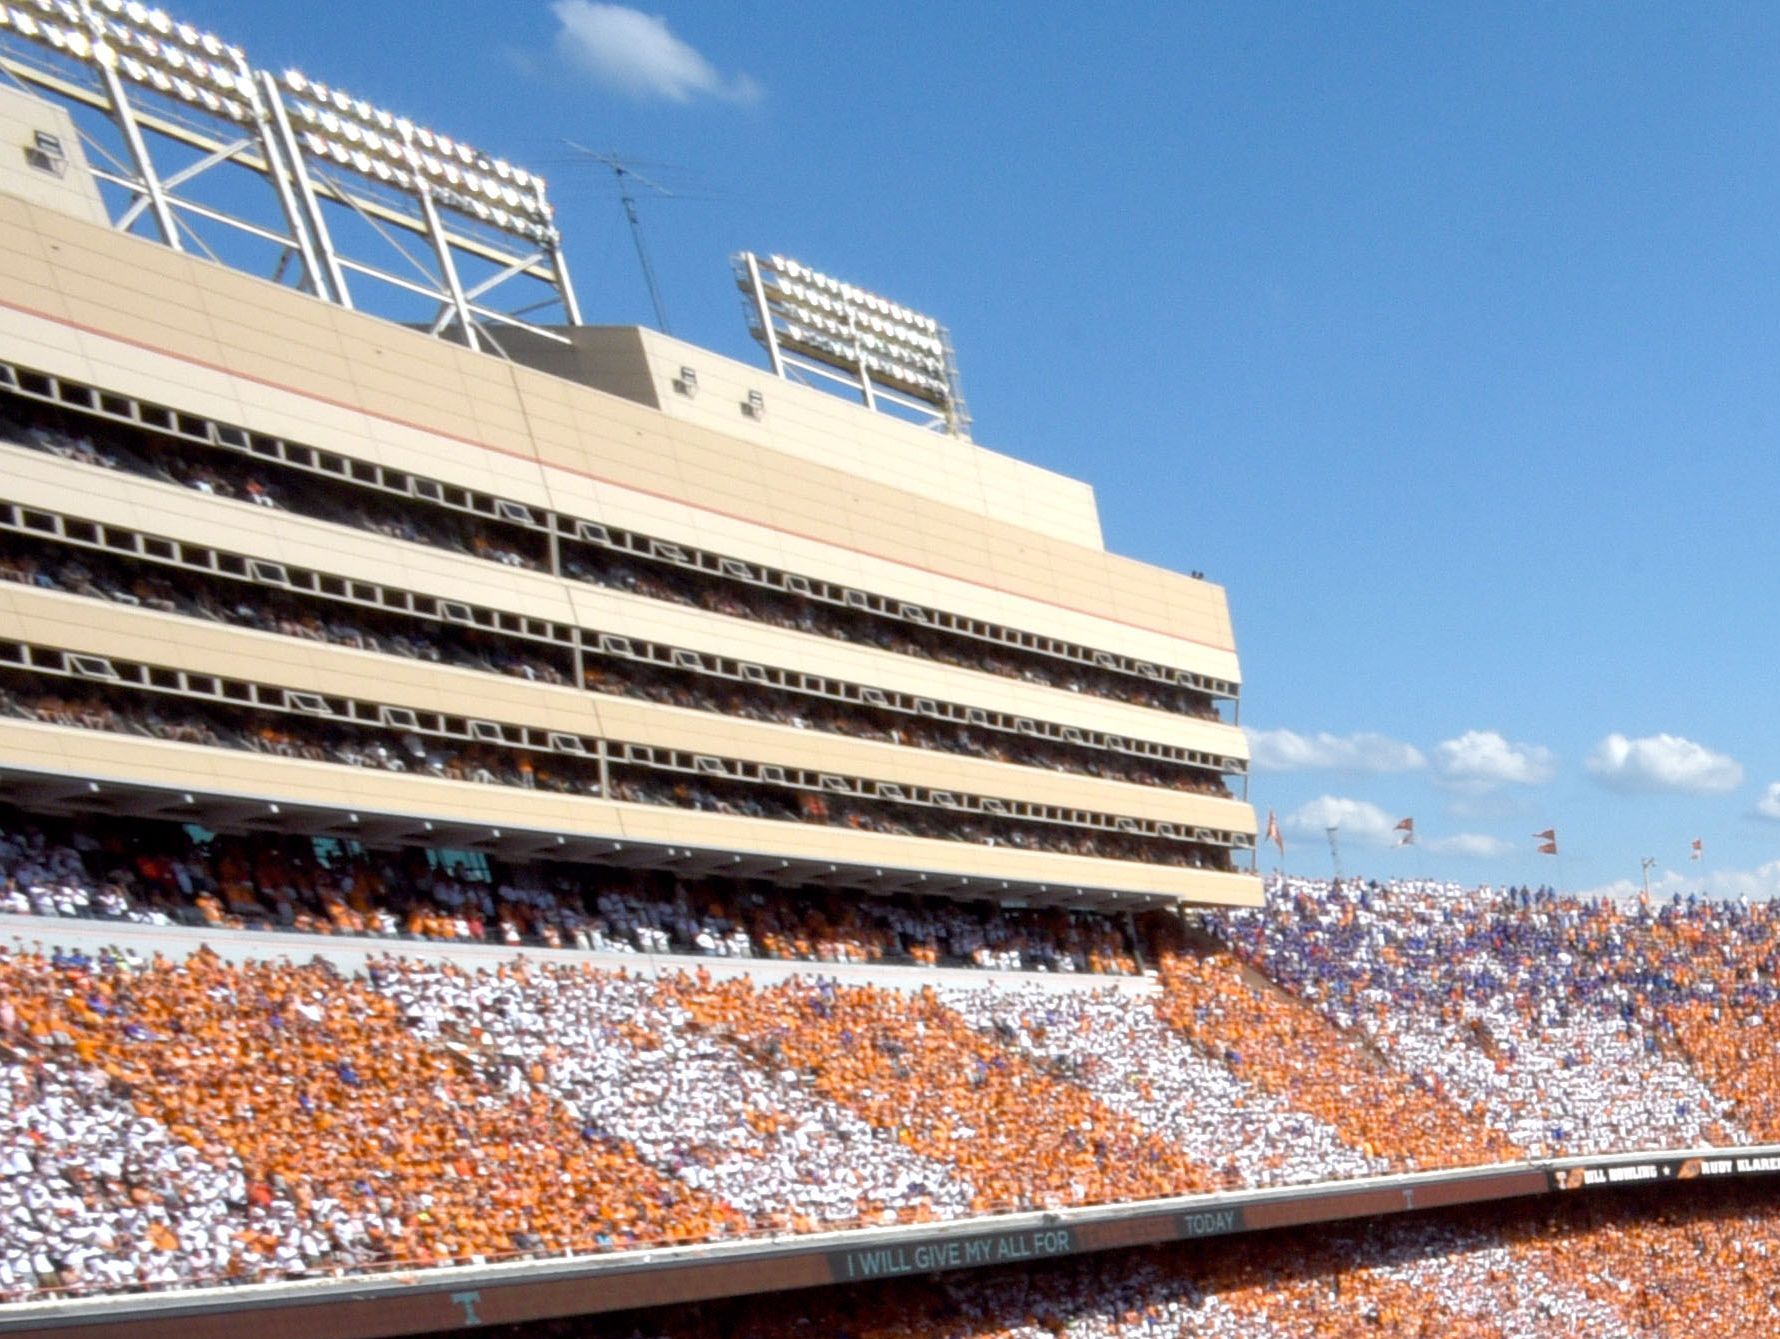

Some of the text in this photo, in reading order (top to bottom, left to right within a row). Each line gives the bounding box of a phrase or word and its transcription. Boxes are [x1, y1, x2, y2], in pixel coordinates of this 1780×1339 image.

[1185, 1212, 1235, 1235] TODAY
[847, 1253, 855, 1277] I
[860, 1250, 912, 1275] WILL
[915, 1244, 961, 1270] GIVE
[964, 1239, 993, 1263] MY
[996, 1235, 1031, 1259] ALL
[1033, 1231, 1070, 1255] FOR
